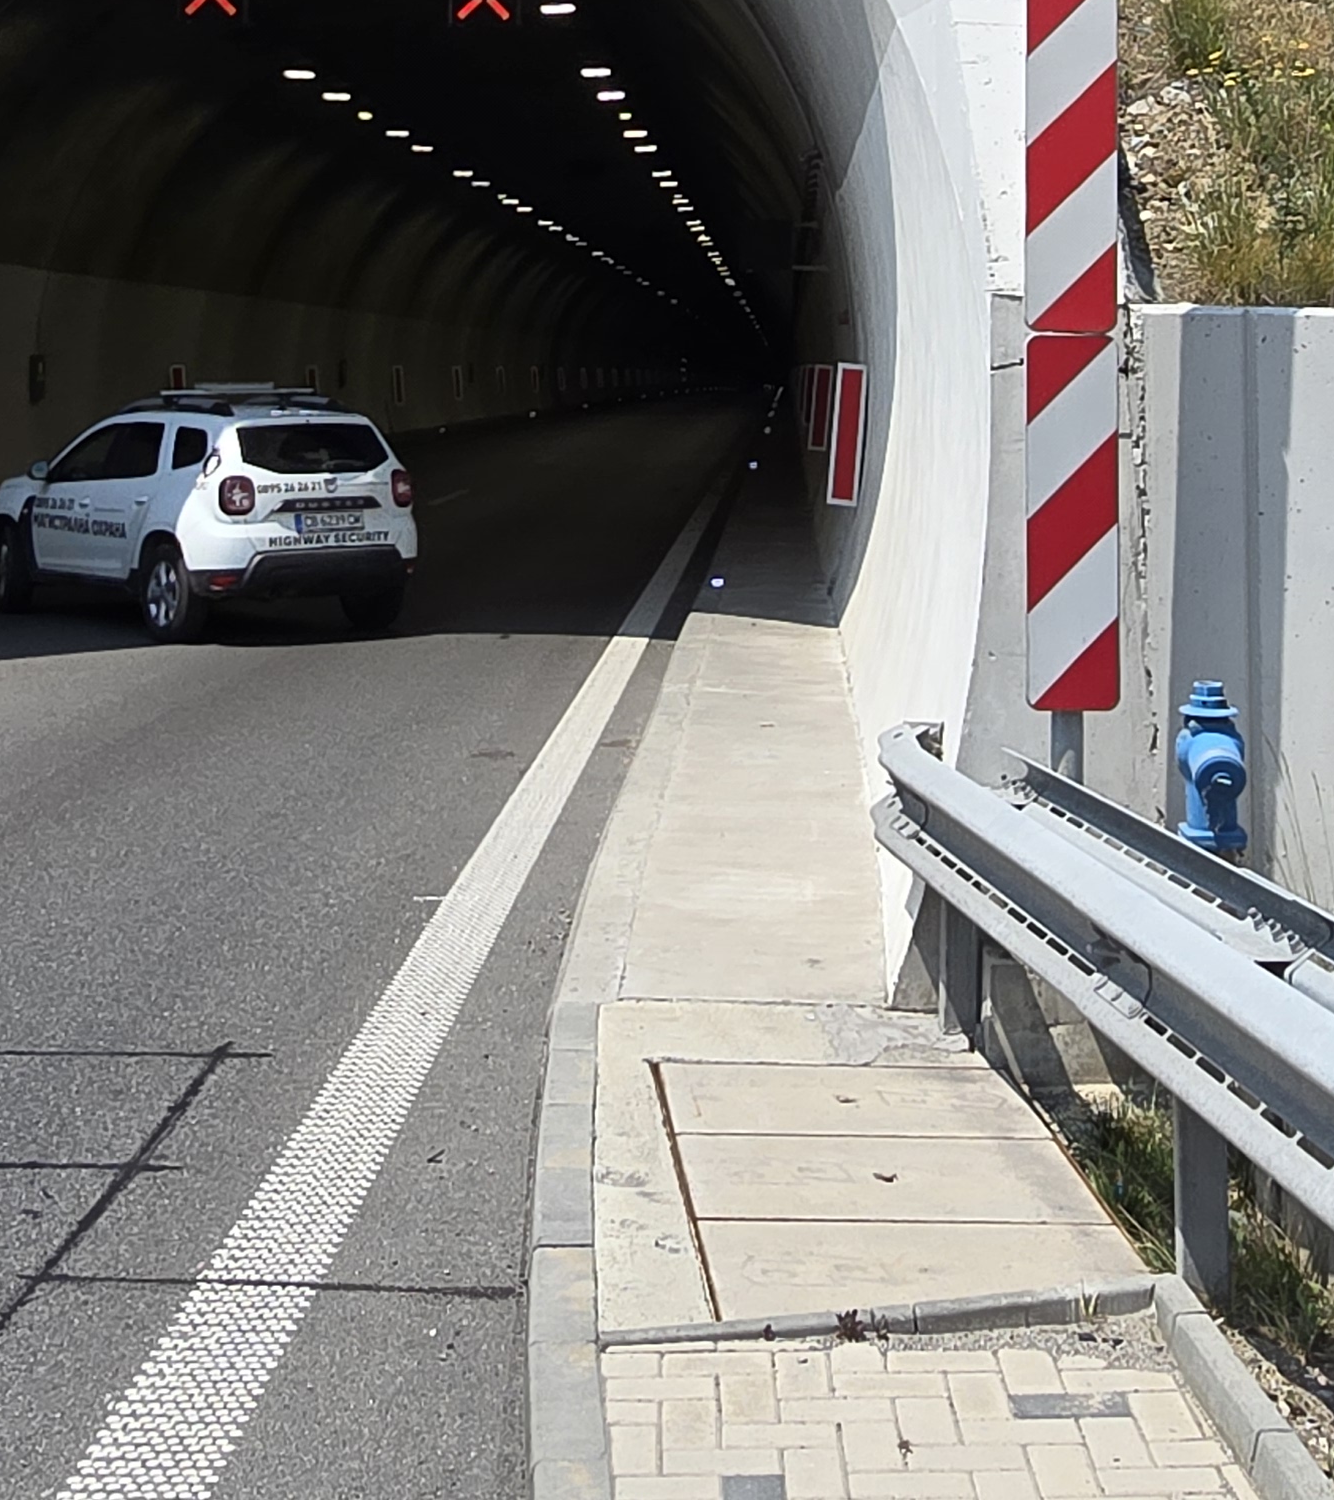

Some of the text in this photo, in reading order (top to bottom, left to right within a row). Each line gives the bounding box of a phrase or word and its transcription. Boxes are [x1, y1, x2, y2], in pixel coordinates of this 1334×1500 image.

[295, 500, 364, 508] DUSTER
[269, 531, 389, 547] HIGHWAY SECURITY
